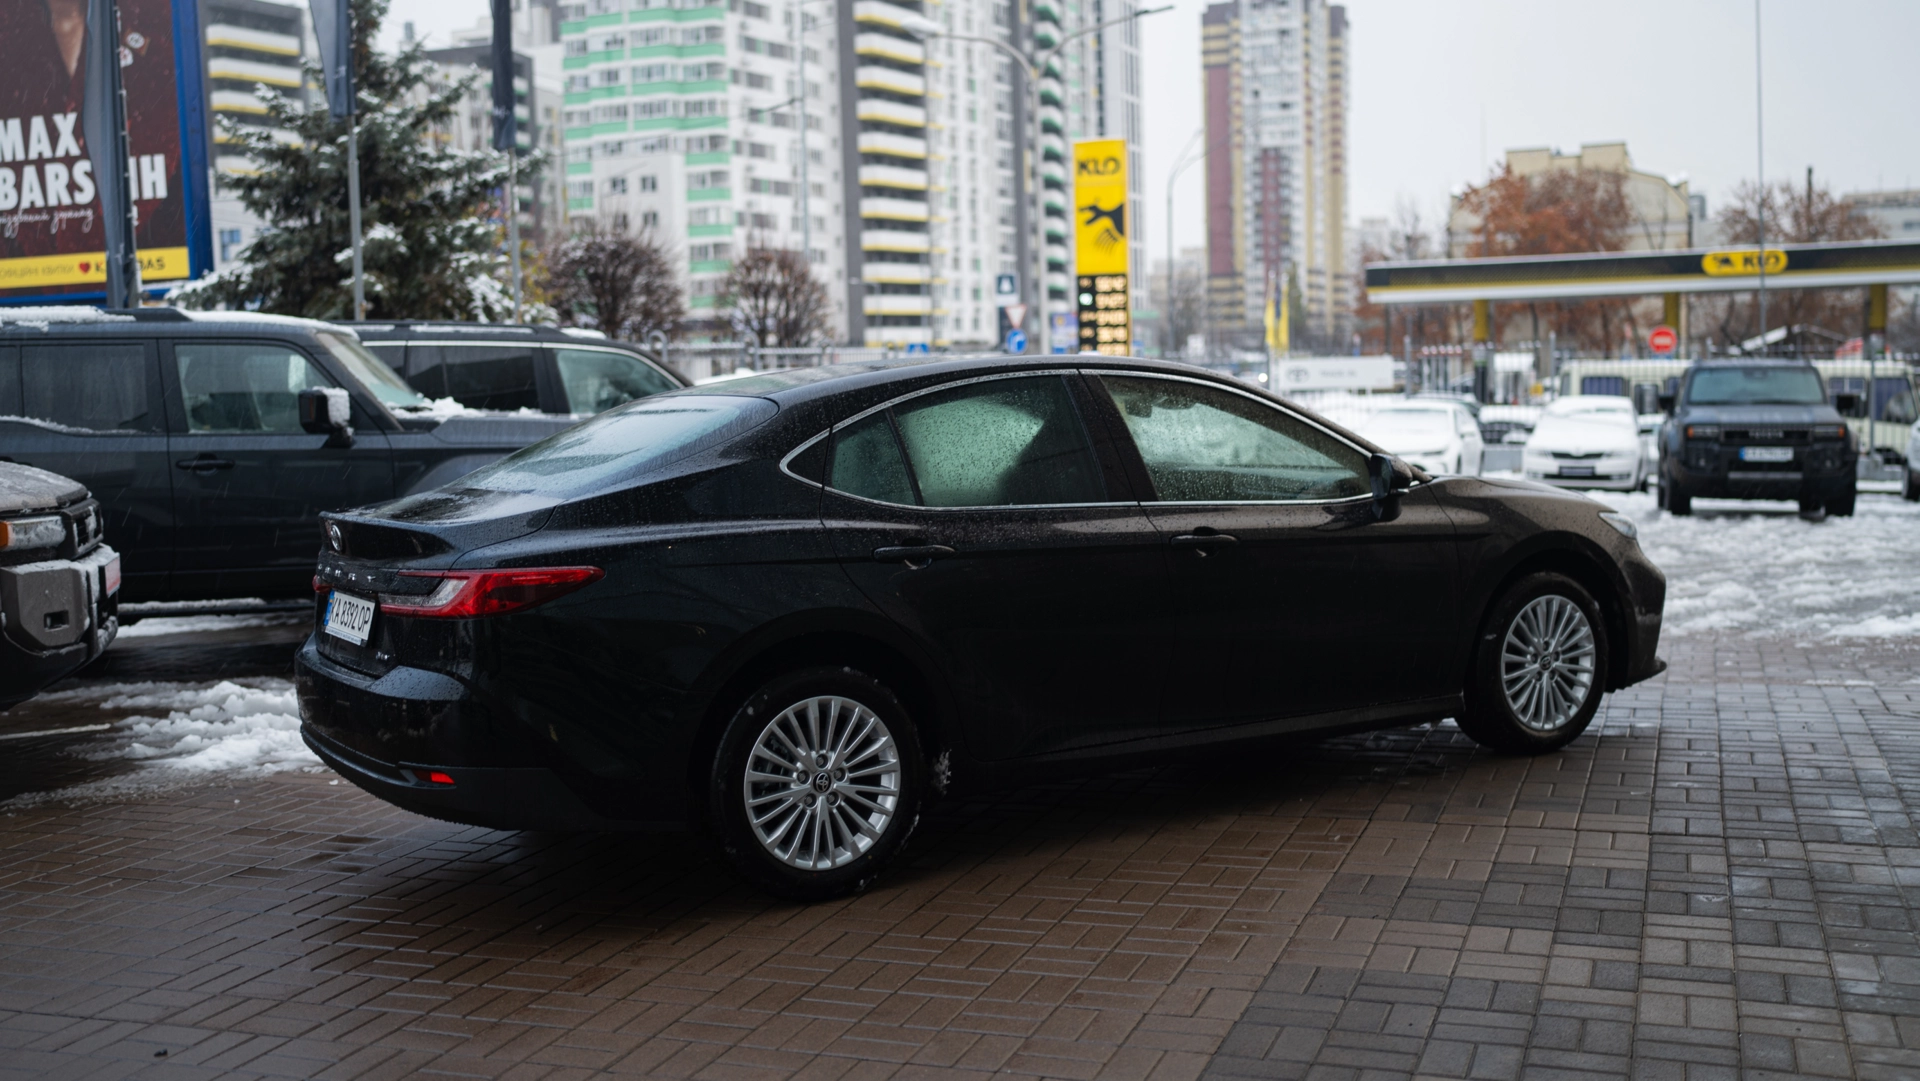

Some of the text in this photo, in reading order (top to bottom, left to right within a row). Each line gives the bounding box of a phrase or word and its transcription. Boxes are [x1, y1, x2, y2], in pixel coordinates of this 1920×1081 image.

[0, 111, 82, 163] MAX
[0, 154, 168, 211] BARSIH
[1077, 156, 1121, 176] KLO
[317, 563, 376, 583] CAMRY
